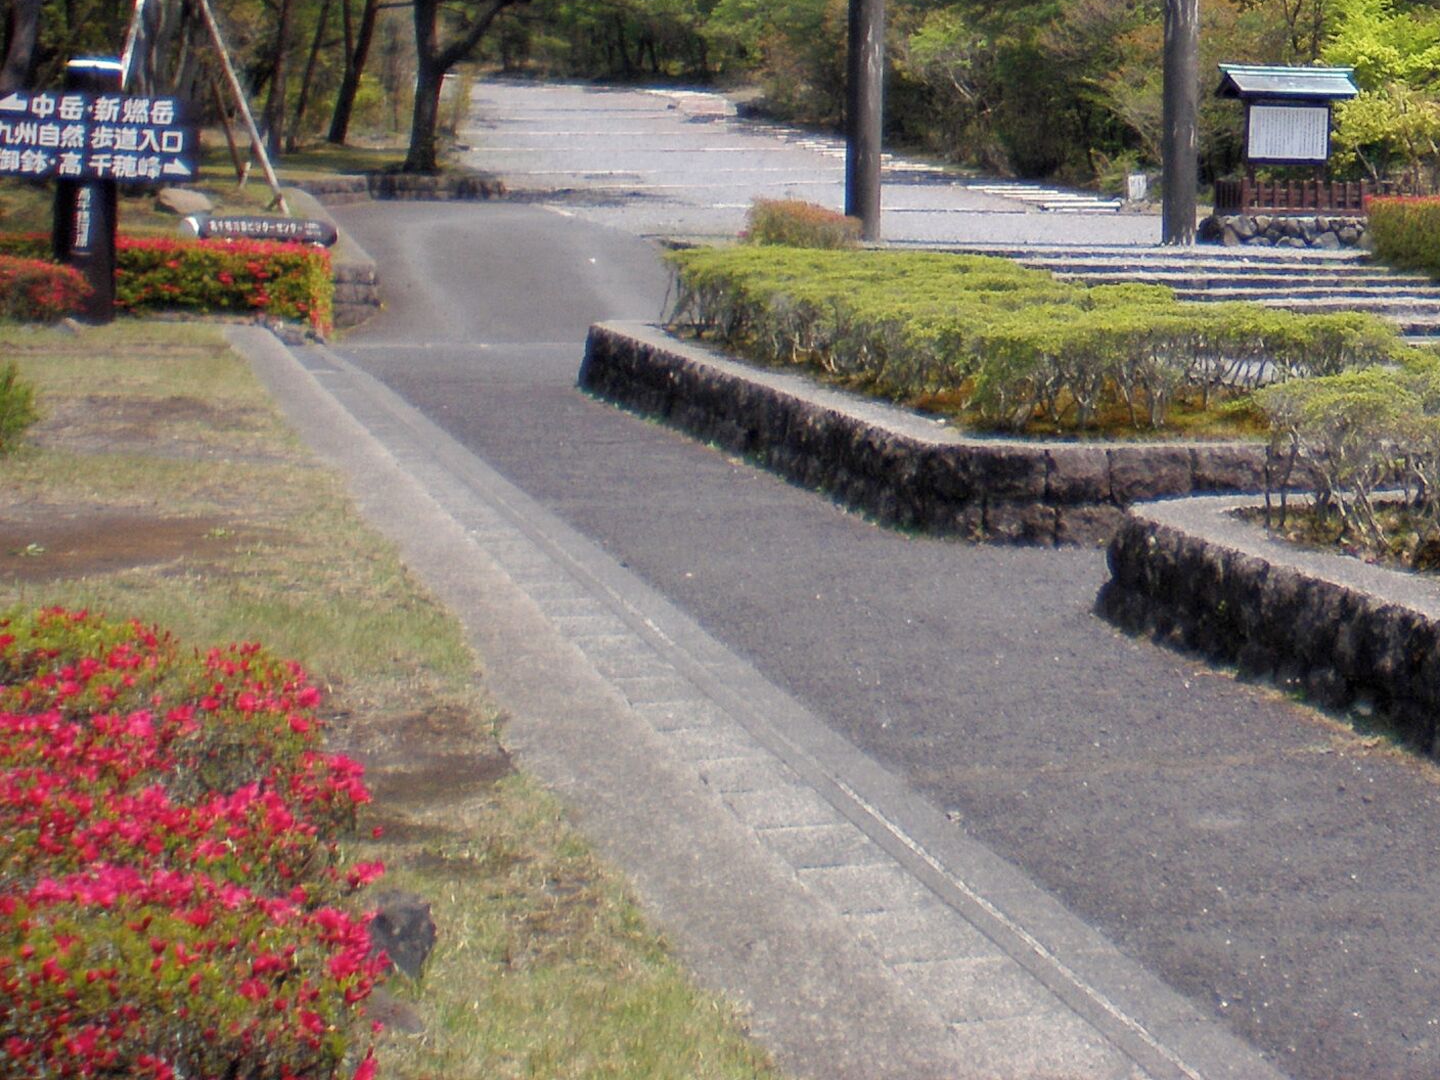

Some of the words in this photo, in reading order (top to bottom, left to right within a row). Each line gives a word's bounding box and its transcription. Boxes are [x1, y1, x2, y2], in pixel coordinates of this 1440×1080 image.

[31, 93, 174, 124] 中岳・新燃岳
